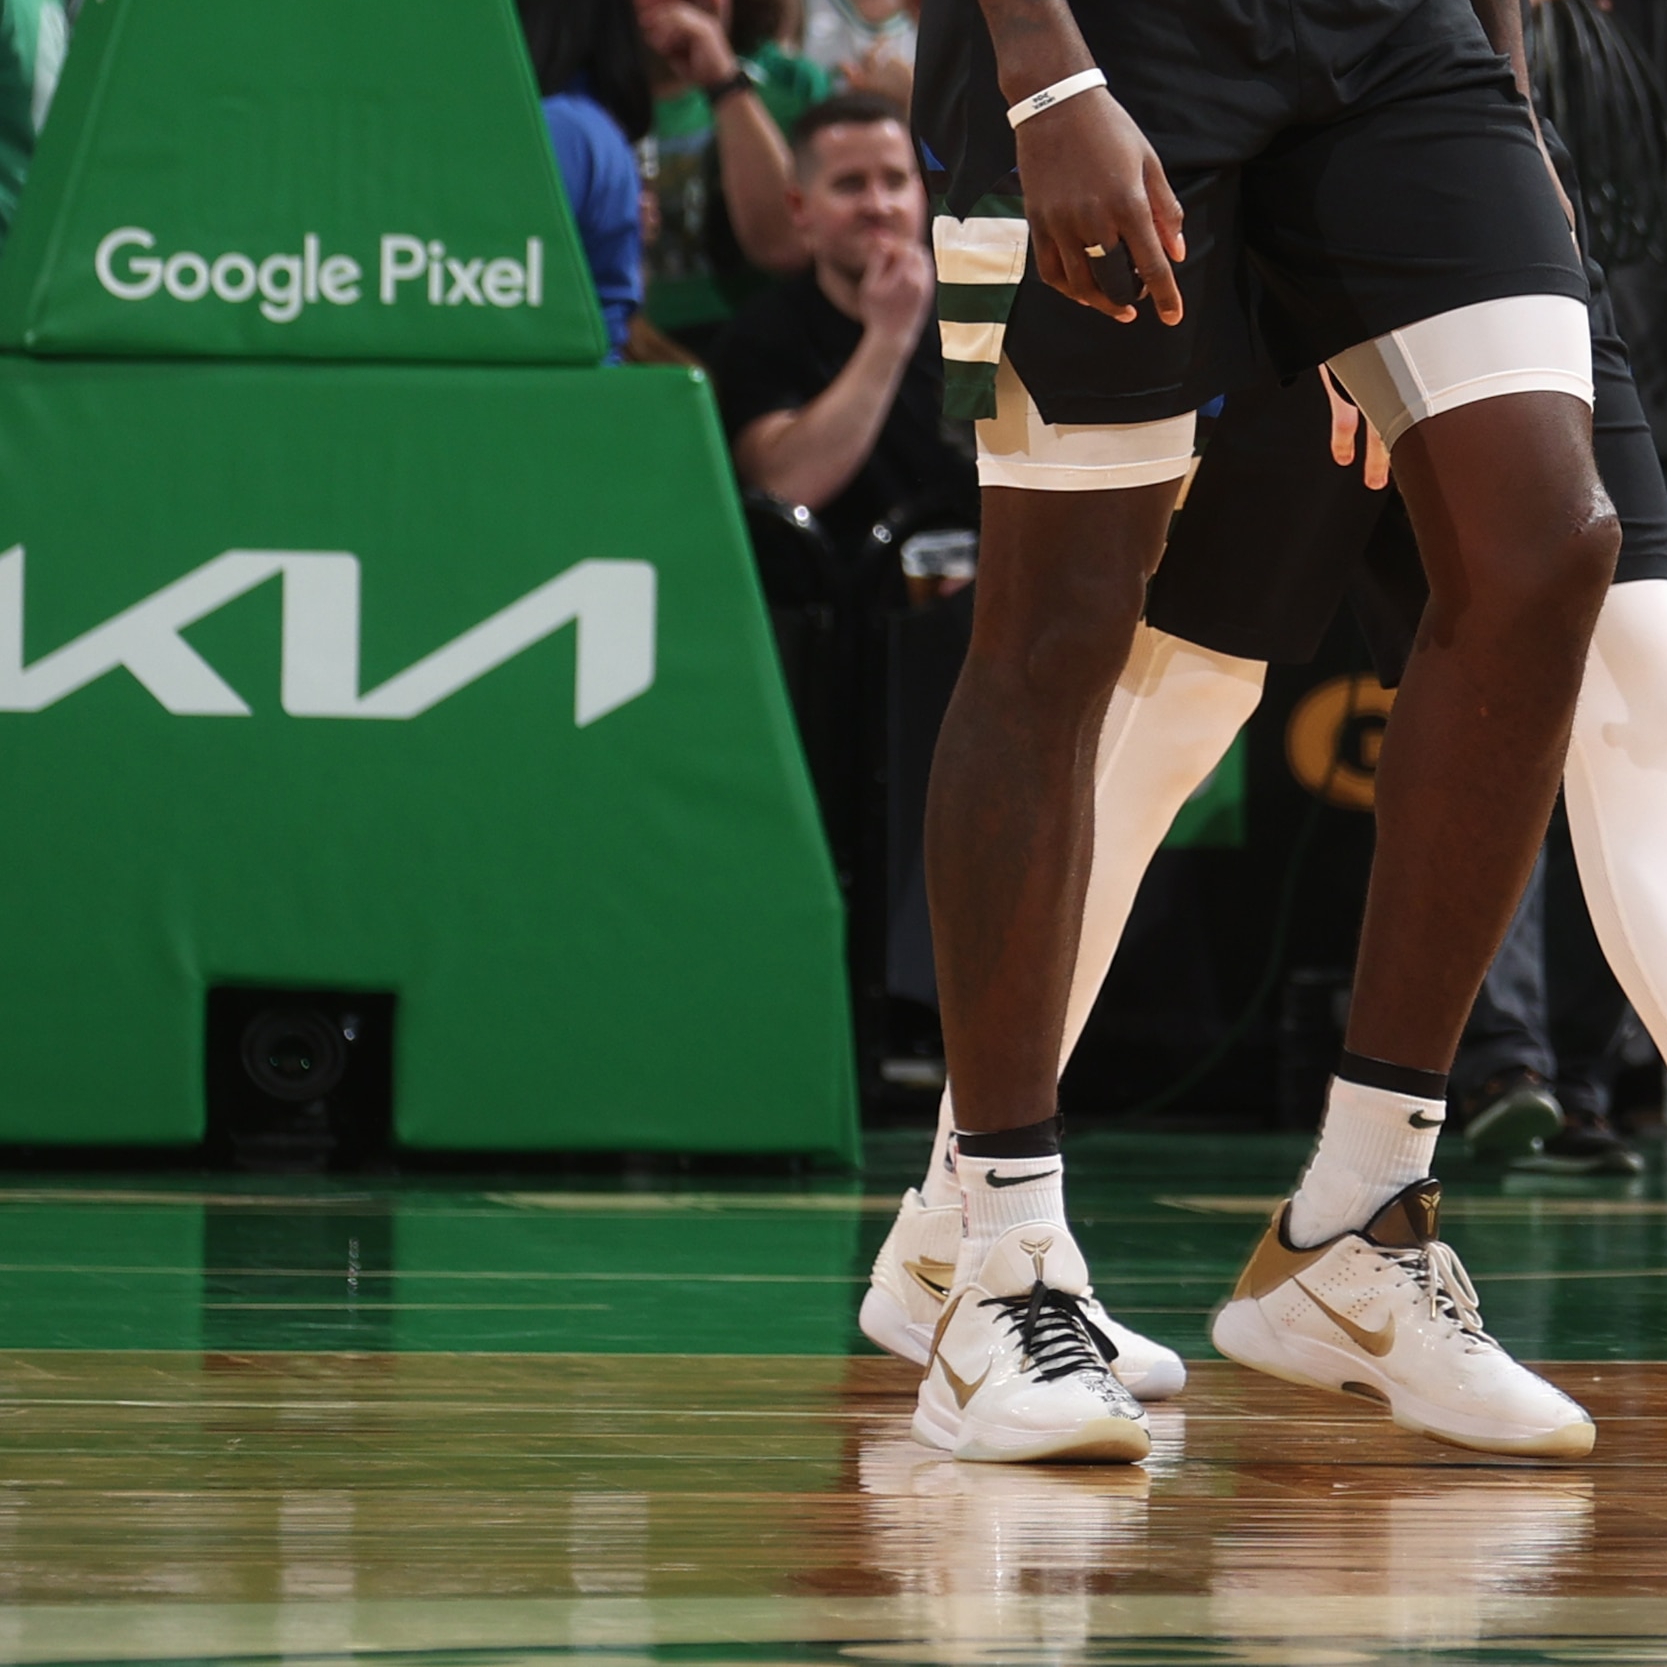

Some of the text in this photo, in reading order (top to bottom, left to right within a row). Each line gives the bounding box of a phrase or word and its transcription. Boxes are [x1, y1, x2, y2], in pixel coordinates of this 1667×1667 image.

[94, 226, 543, 324] Google Pixel
[0, 542, 657, 728] KIA
